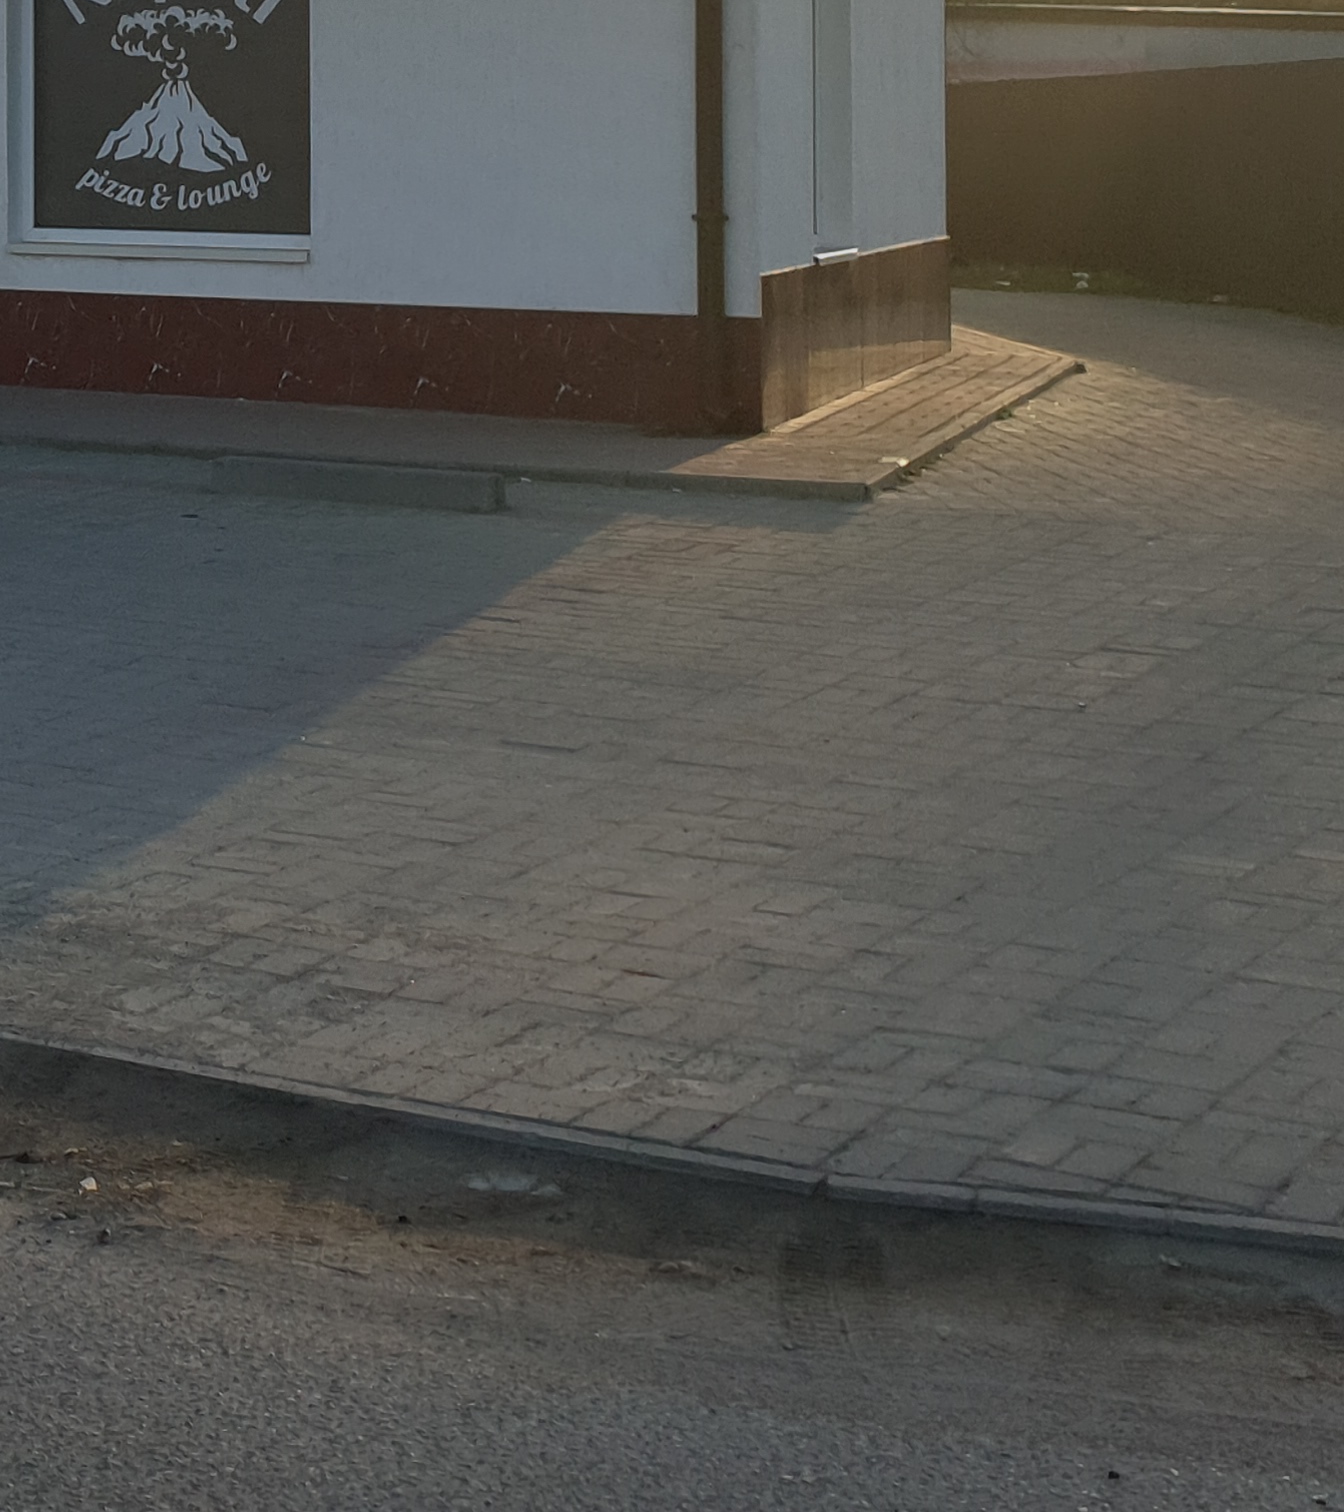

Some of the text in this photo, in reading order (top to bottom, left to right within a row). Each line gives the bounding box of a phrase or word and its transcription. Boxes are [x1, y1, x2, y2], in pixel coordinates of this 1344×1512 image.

[74, 161, 273, 211] pizza & lounge
